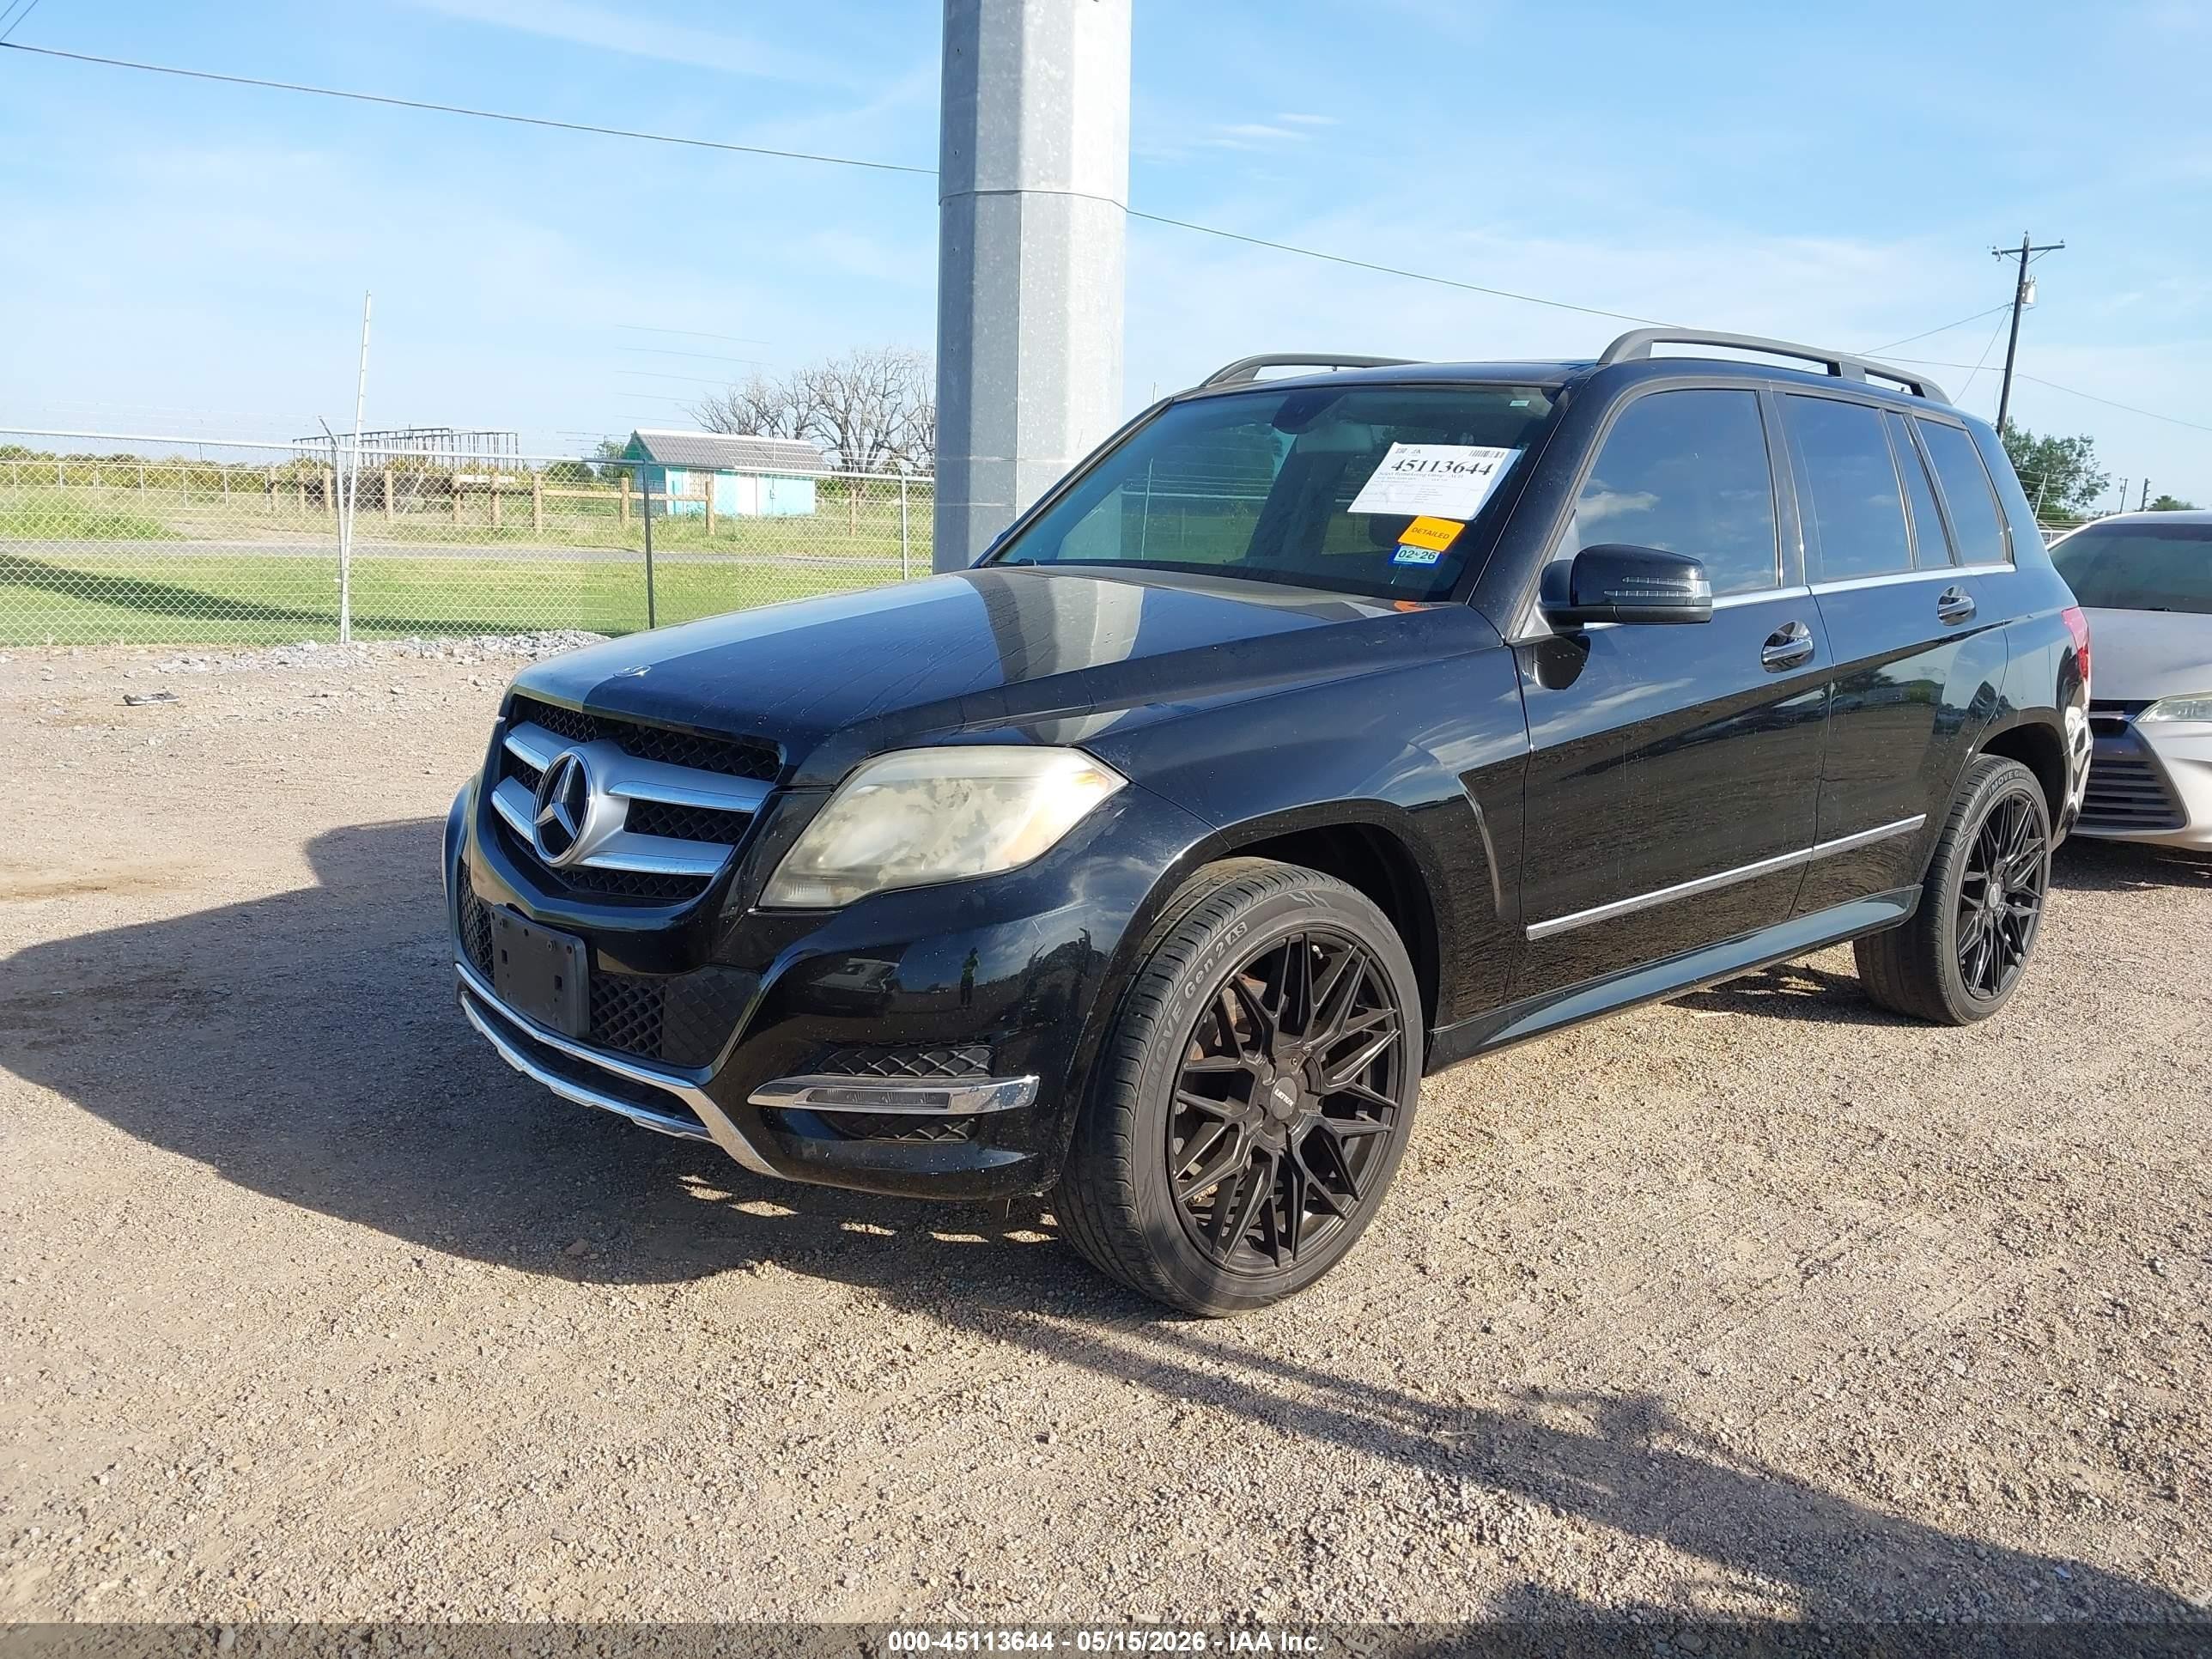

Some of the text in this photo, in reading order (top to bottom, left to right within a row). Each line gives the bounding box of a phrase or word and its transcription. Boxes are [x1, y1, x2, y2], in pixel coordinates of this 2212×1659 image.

[1390, 458, 1494, 476] 45113644
[1411, 527, 1450, 540] DETAILED
[1184, 957, 1214, 1000] Gen
[1228, 923, 1246, 943] AS
